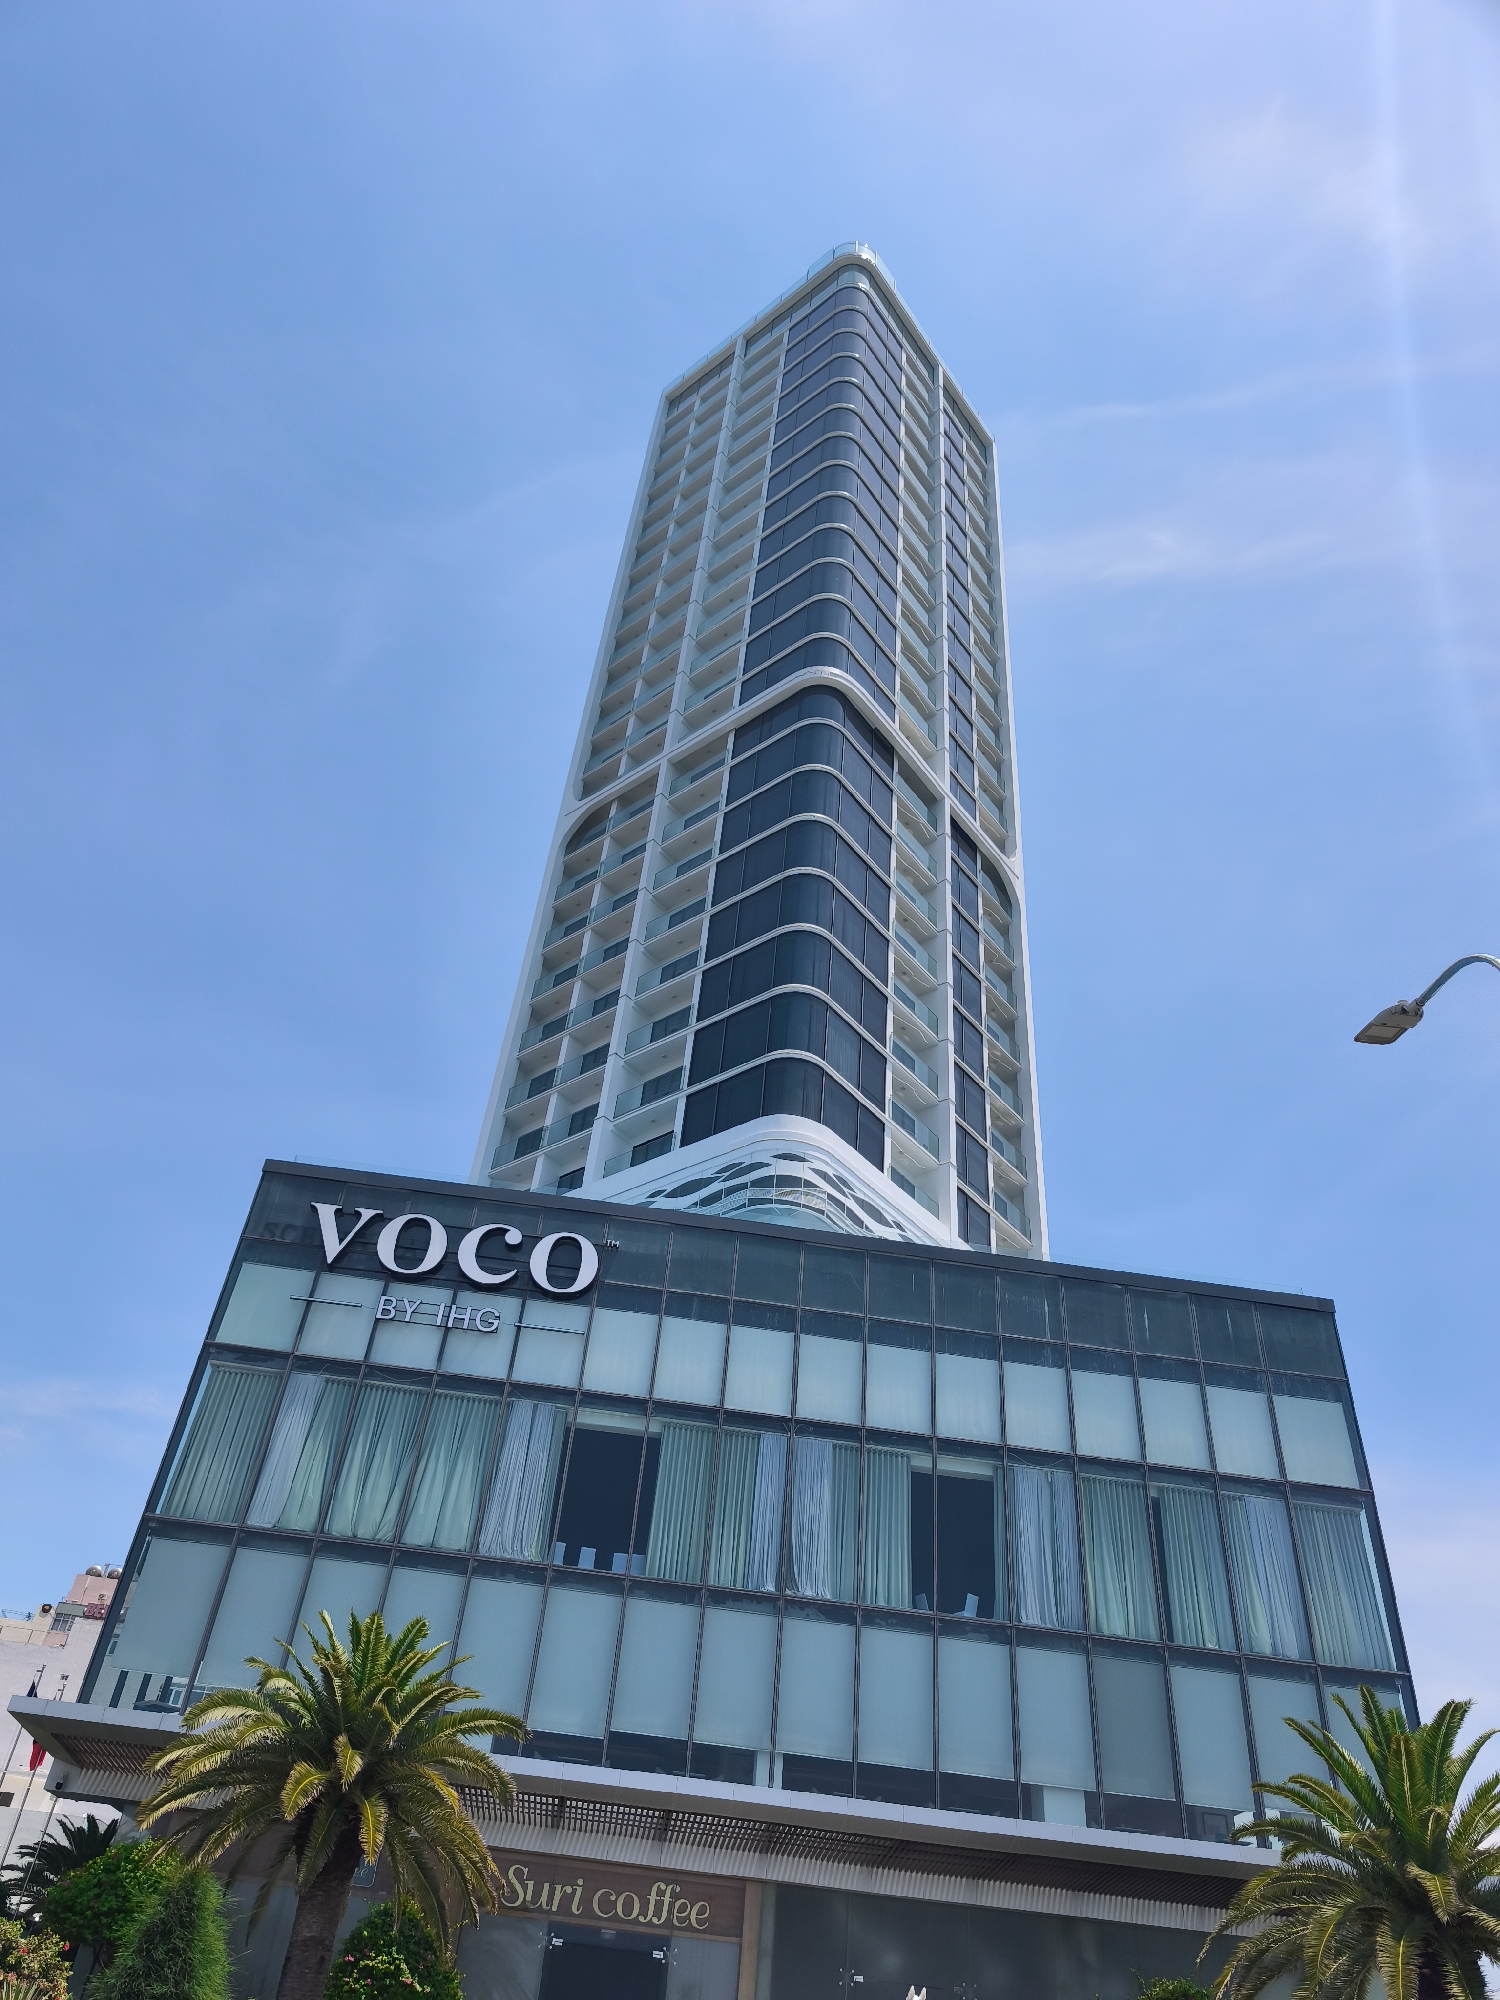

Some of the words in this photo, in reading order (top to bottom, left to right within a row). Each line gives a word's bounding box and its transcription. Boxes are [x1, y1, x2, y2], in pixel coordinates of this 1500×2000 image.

[375, 1295, 422, 1322] BY
[436, 1302, 500, 1332] IHG
[500, 1864, 585, 1915] Suri
[592, 1881, 710, 1930] coffee
